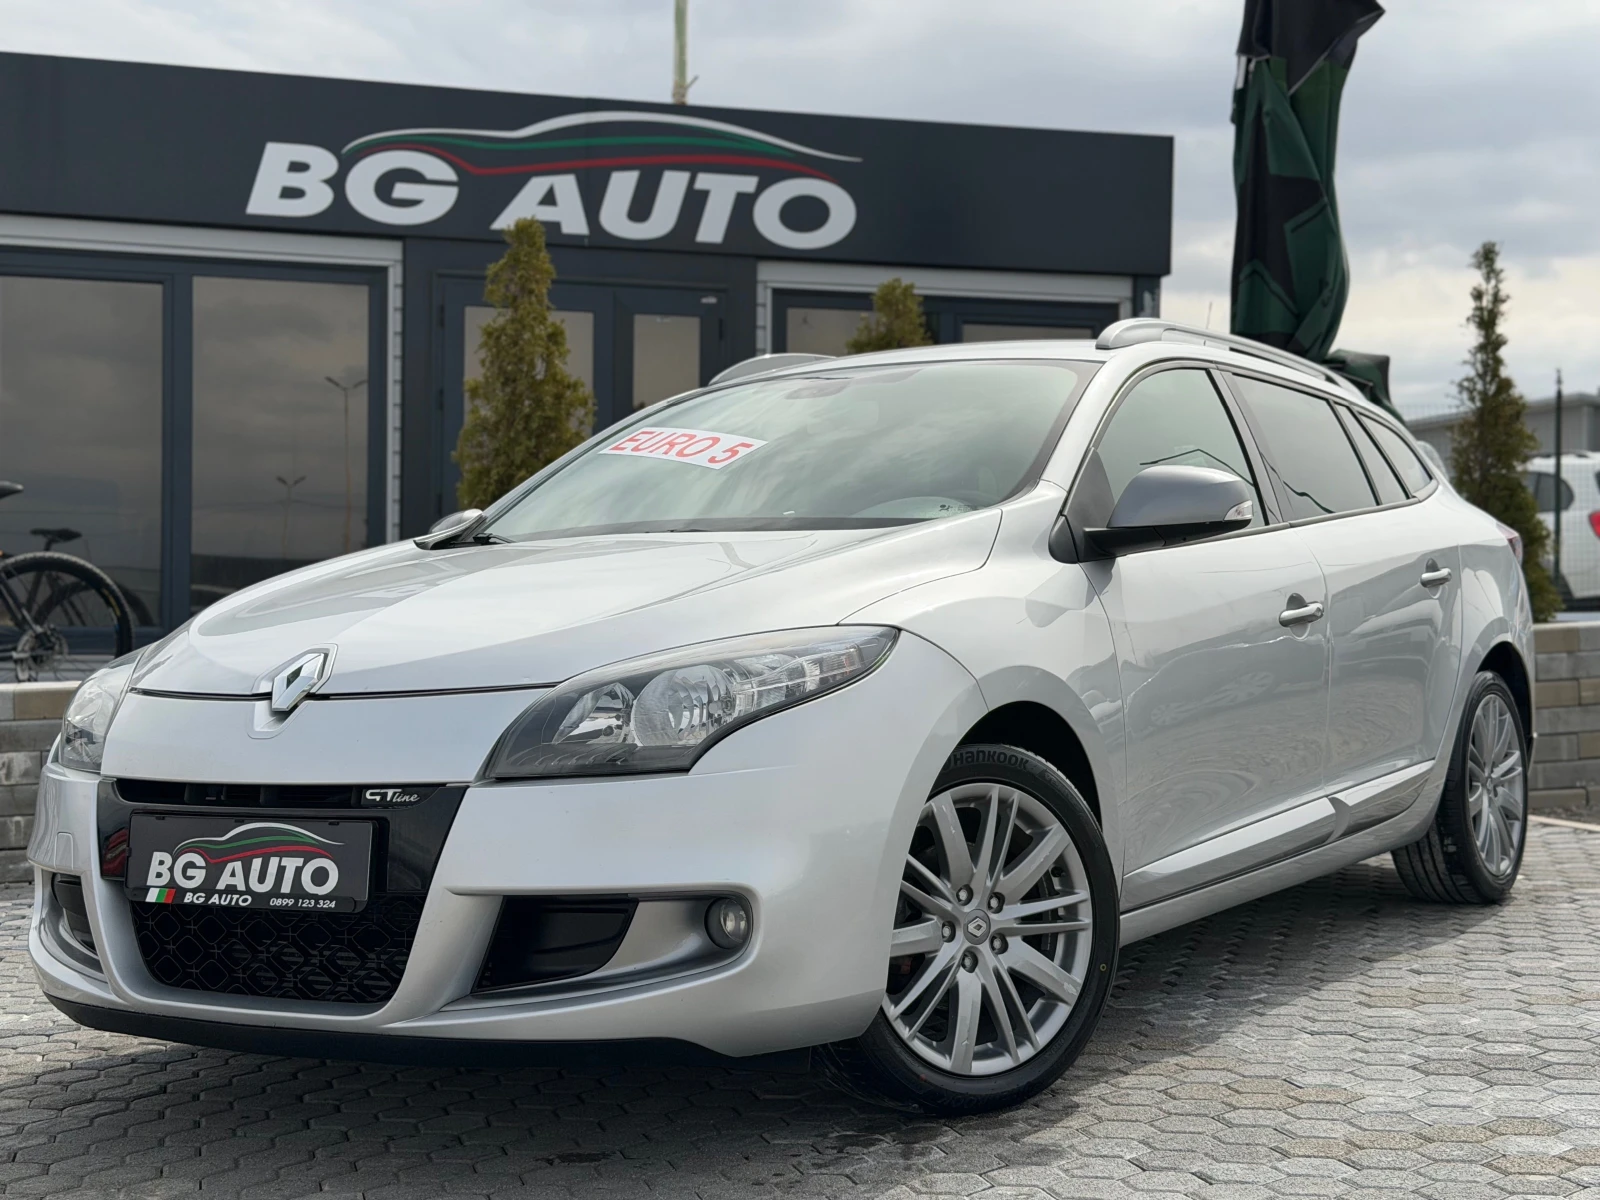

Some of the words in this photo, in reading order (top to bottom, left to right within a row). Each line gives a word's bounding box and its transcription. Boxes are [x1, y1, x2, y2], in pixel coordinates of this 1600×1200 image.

[246, 142, 459, 225] BG
[490, 170, 857, 249] AUTO
[609, 431, 721, 457] EURO
[707, 442, 754, 464] 5
[146, 851, 206, 889] BG
[215, 856, 339, 895] AUTO
[183, 891, 206, 904] BG
[208, 893, 252, 907] AUTO
[269, 897, 295, 907] 0899
[298, 898, 315, 908] 123
[316, 899, 336, 909] 324
